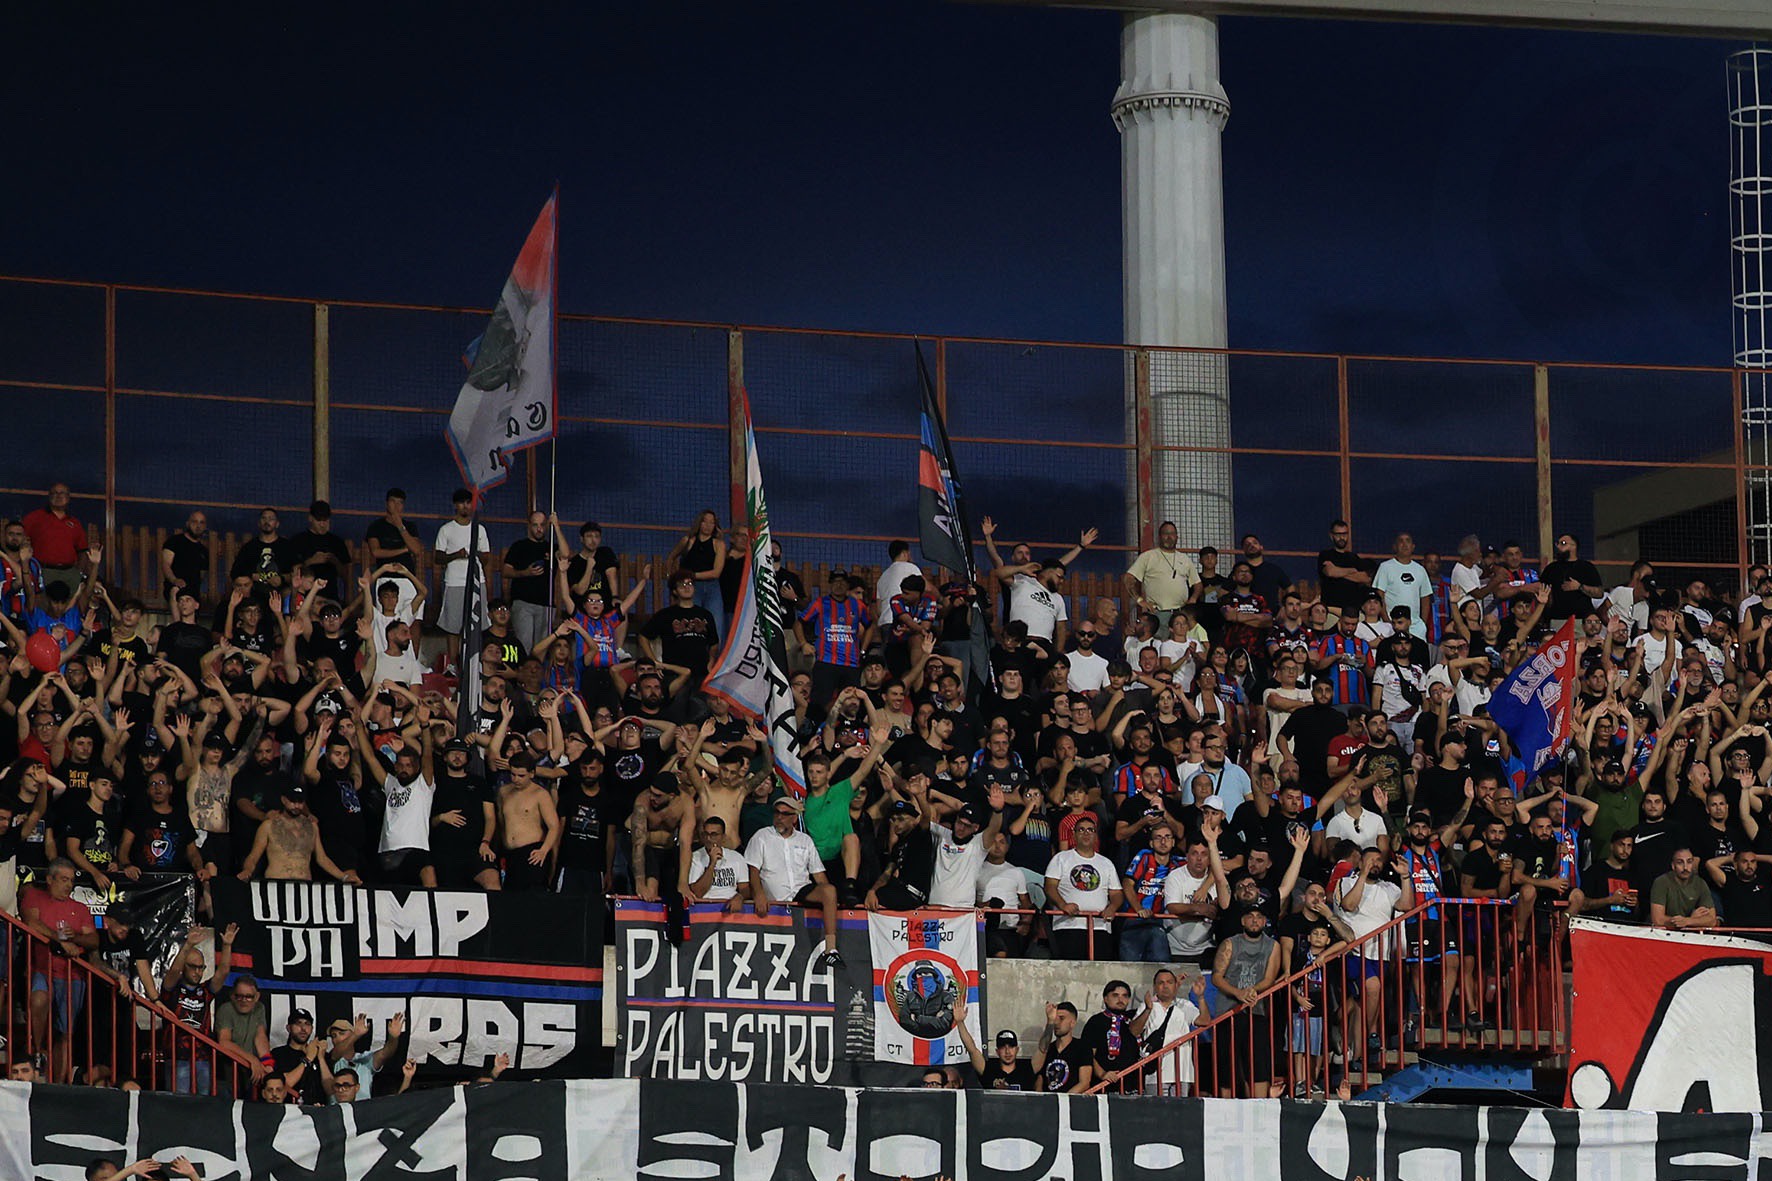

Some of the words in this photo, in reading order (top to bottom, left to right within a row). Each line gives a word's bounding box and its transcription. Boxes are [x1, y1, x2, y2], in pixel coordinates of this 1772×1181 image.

[892, 931, 954, 943] PALESTRO
[901, 920, 945, 932] PIAZZA
[626, 928, 835, 1002] PIAZZA
[270, 993, 576, 1069] UTRAS
[624, 1010, 834, 1084] PALESTRO
